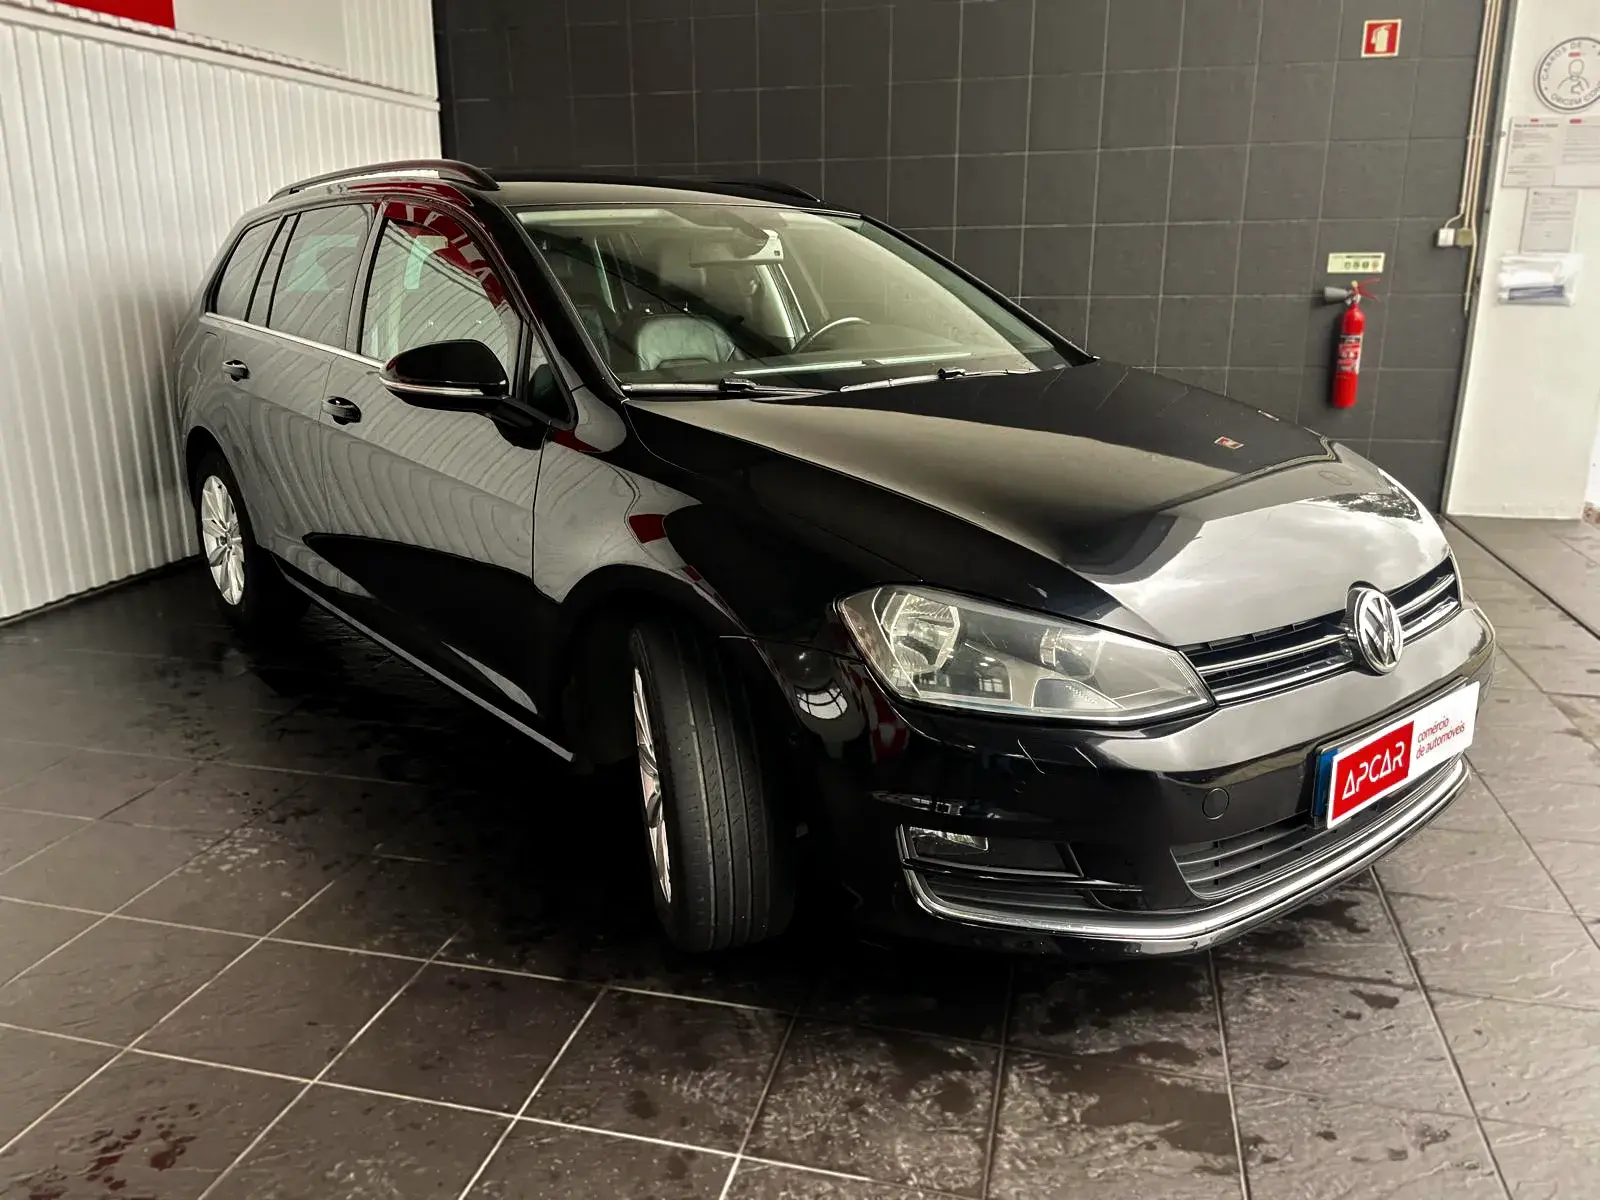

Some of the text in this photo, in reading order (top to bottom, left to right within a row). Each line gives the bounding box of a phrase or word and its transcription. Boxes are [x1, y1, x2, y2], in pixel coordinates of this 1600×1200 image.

[1416, 720, 1466, 759] de automóveis
[1417, 716, 1449, 743] comércio
[1342, 741, 1405, 800] APCAR
